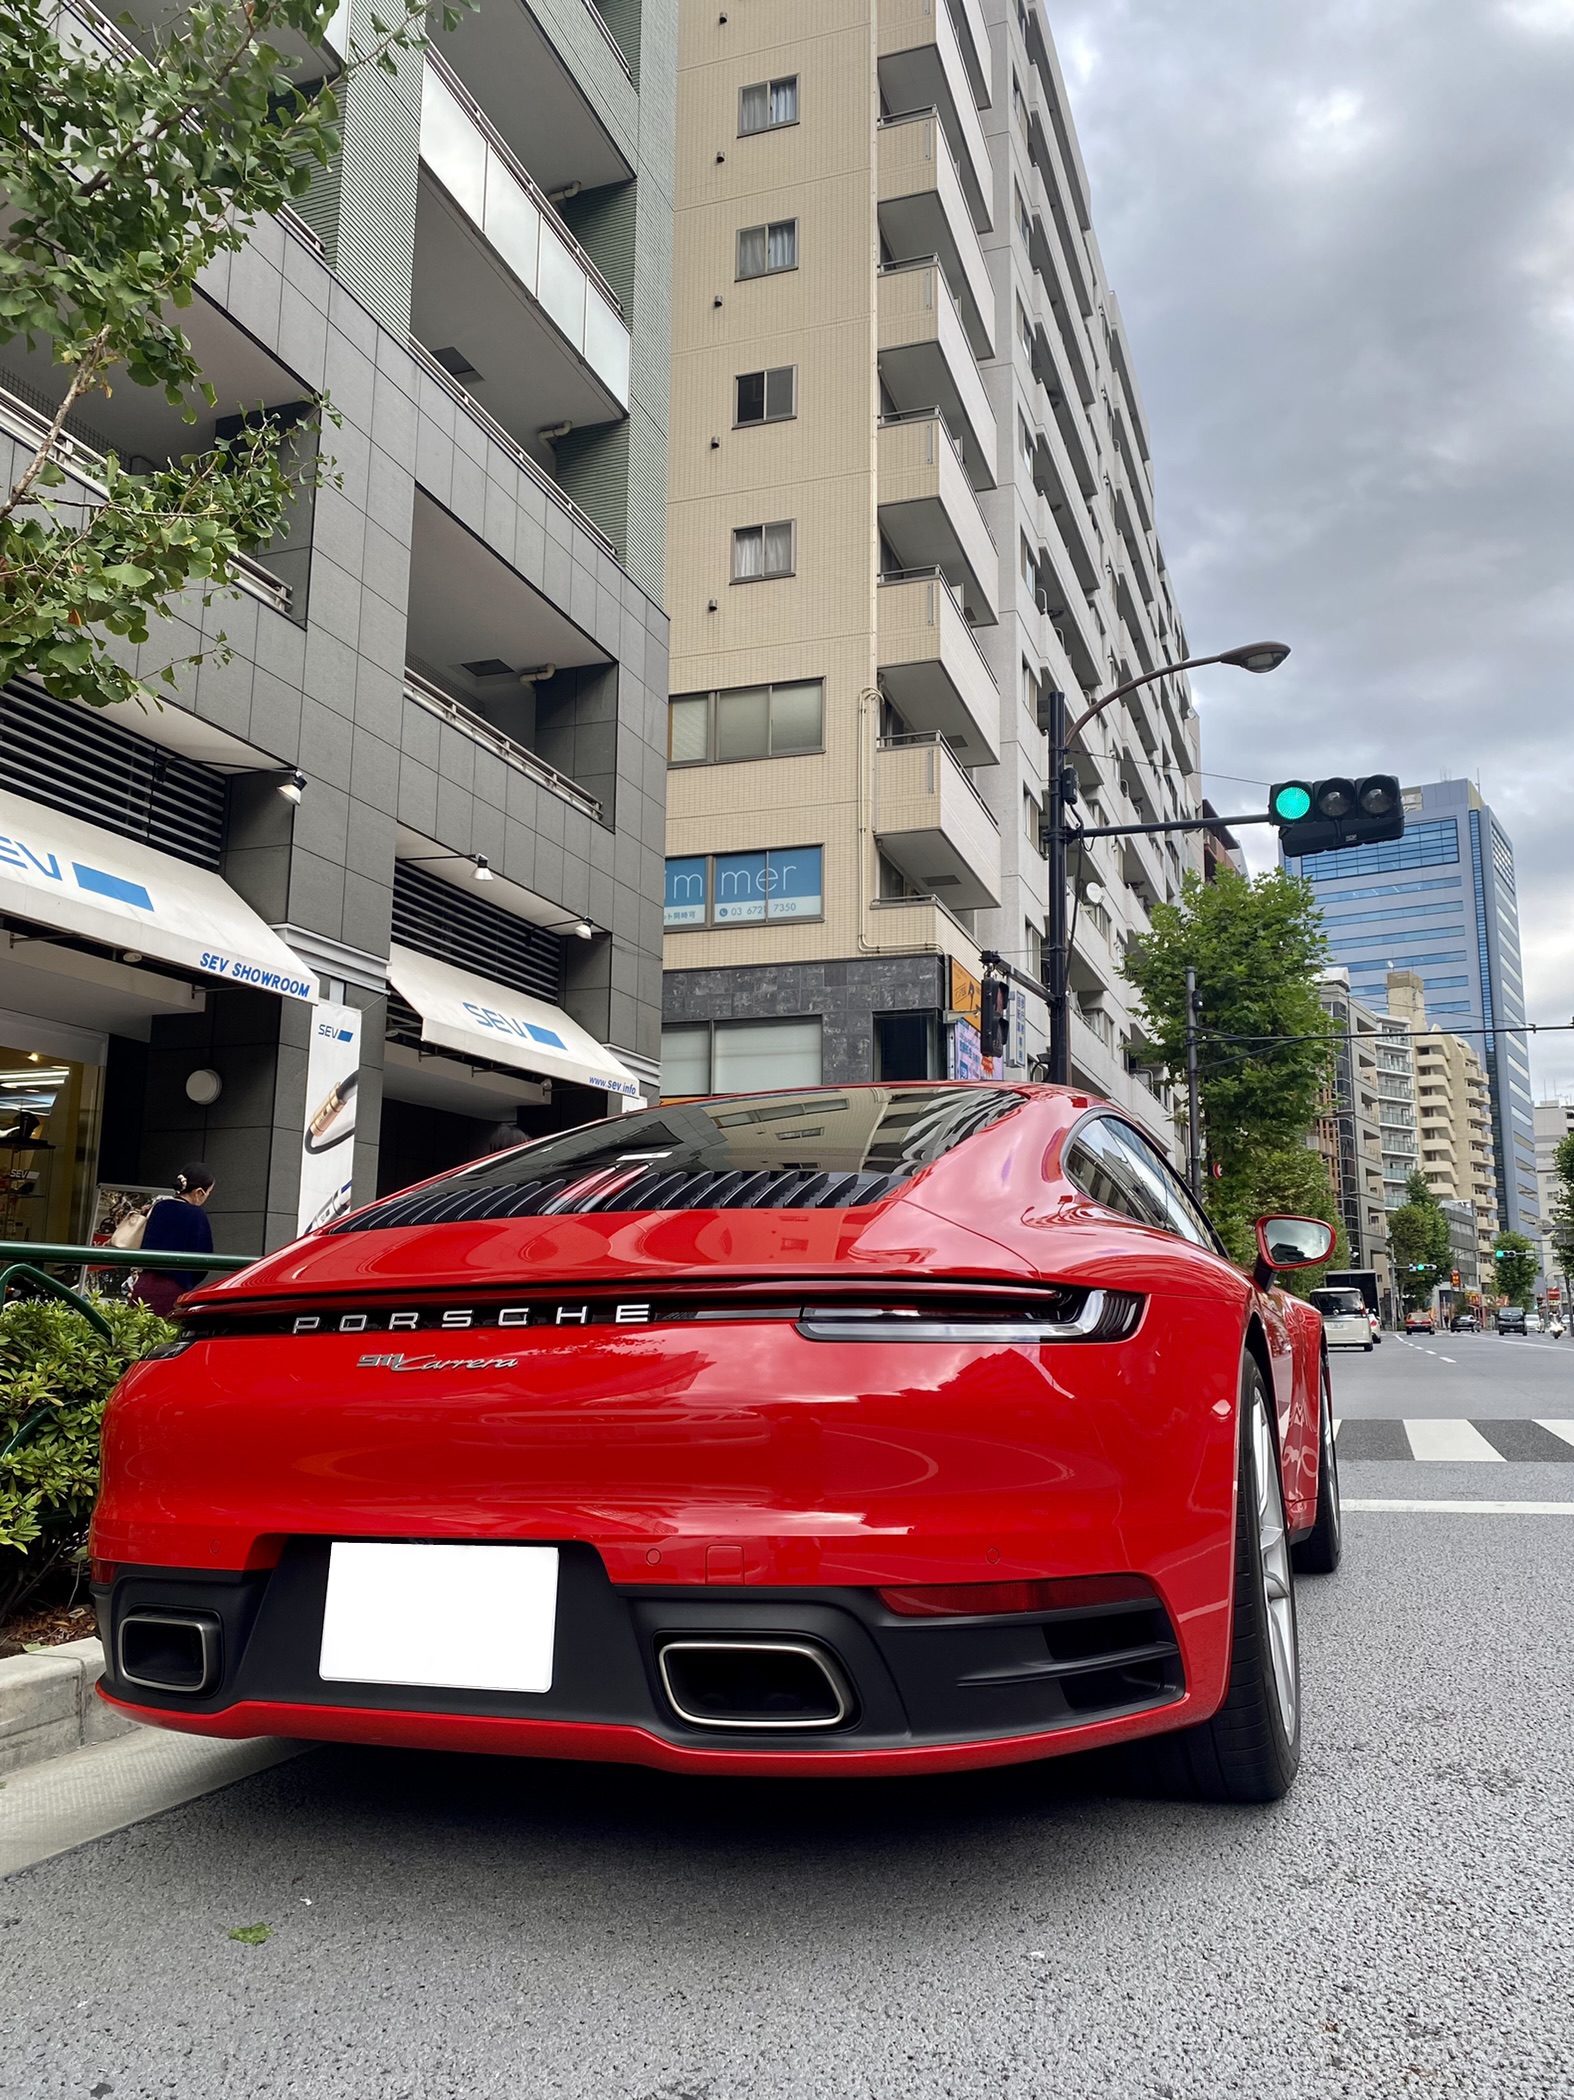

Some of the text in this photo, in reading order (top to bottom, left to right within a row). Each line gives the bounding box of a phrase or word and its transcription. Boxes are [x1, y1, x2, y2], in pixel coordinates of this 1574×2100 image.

[731, 907, 742, 916] 03
[774, 902, 796, 912] 7350
[199, 952, 310, 998] SEV SHOWROOM
[462, 1001, 528, 1039] SEV
[318, 1023, 339, 1039] SEV
[588, 1075, 637, 1095] www.sev.info
[9, 1168, 28, 1179] SEV
[292, 1303, 651, 1334] PORSCHE
[391, 1354, 518, 1372] Carrera
